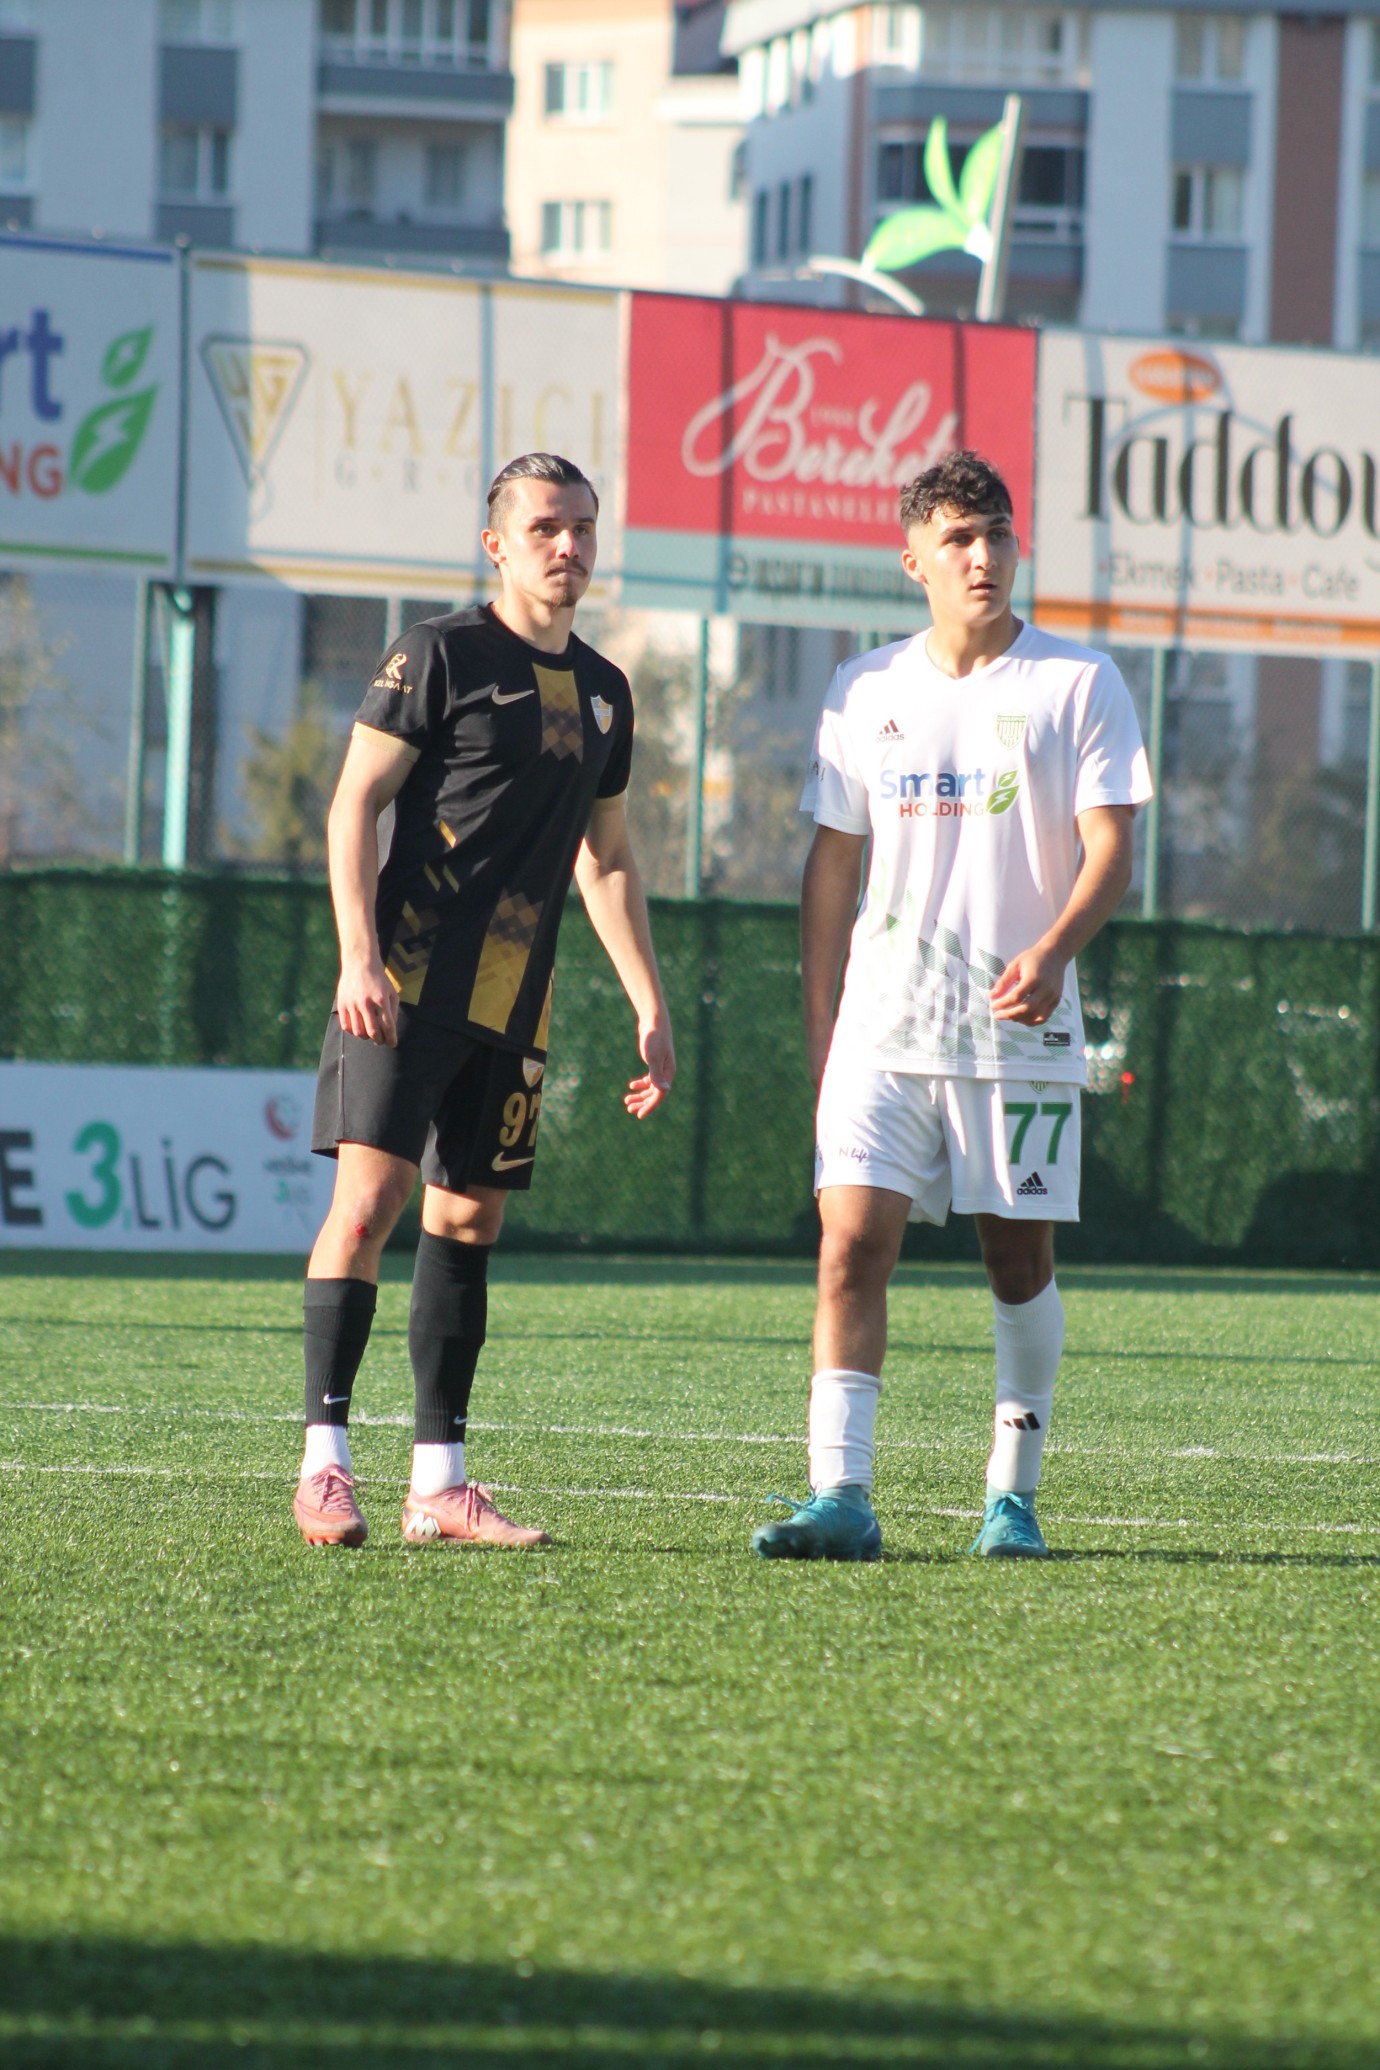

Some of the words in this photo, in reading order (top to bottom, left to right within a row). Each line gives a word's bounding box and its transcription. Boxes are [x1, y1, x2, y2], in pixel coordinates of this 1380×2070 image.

[1216, 557, 1284, 597] Pasta
[1302, 562, 1360, 602] Cafe
[880, 768, 986, 799] Smart
[900, 802, 985, 818] HOLDING
[1003, 1103, 1073, 1166] 77
[1016, 1186, 1048, 1196] adidas
